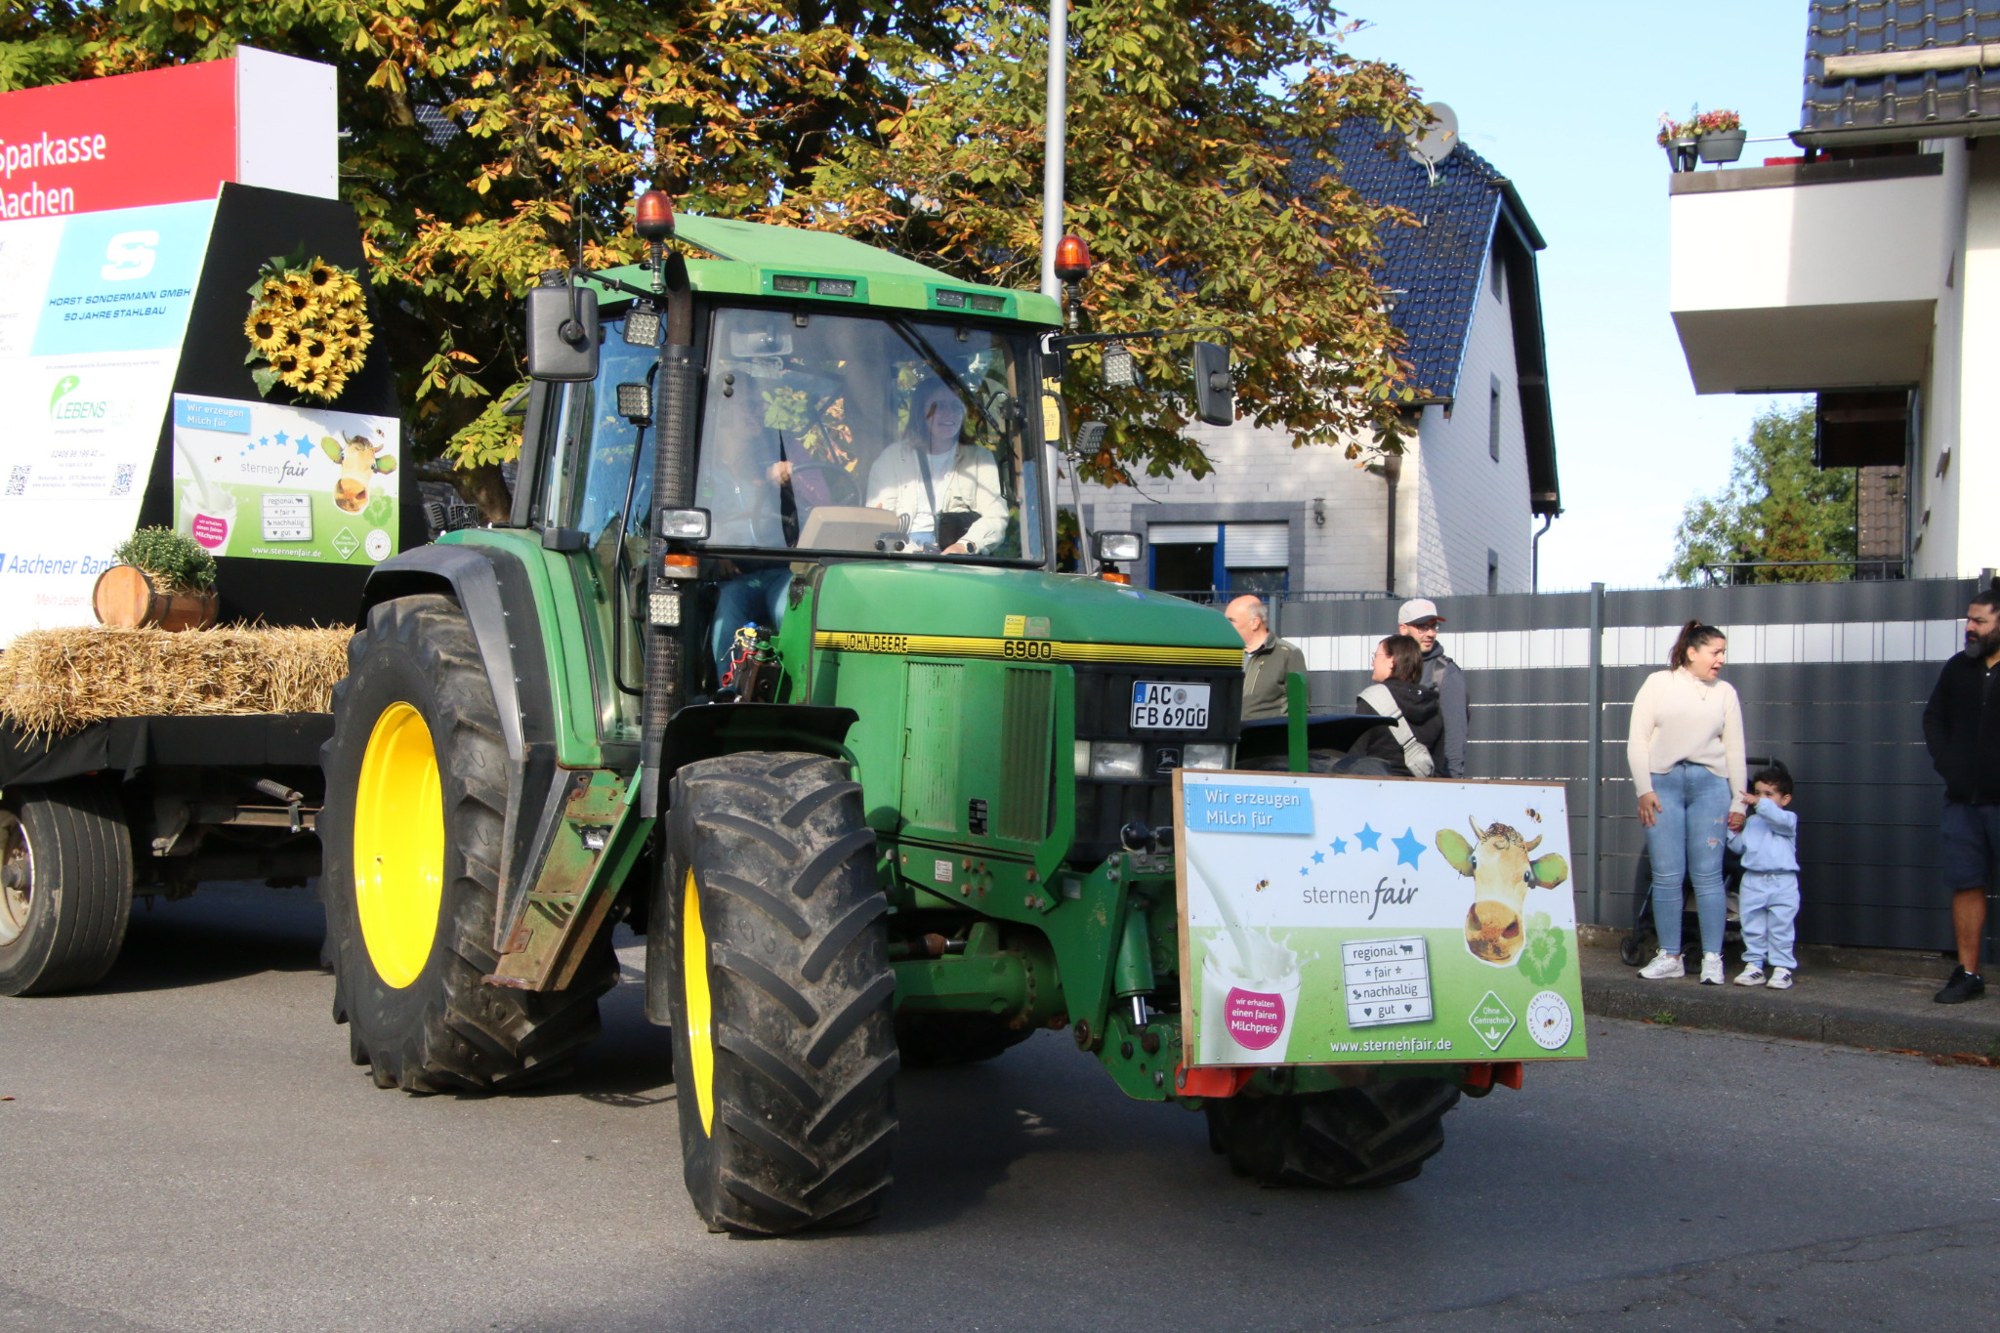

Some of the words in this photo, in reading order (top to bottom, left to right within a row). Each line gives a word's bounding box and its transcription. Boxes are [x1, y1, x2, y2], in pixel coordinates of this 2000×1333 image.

[49, 299, 84, 307] HORST
[85, 292, 157, 305] SONDERMANN
[159, 289, 193, 299] GMBH
[63, 313, 78, 322] 50
[78, 310, 113, 321] JAHRE
[112, 306, 167, 318] STAHLBAU
[186, 402, 203, 413] Wir
[204, 406, 244, 418] erzeugen
[187, 415, 211, 426] Milch
[214, 417, 227, 428] für
[268, 498, 294, 507] regional
[279, 509, 291, 517] fair
[280, 528, 292, 538] gut
[252, 546, 323, 559] www.sternenfair.de
[7, 553, 78, 575] Aachener
[843, 634, 870, 649] JOHN
[873, 635, 908, 652] DEERE
[1004, 640, 1052, 660] 6900
[1148, 685, 1172, 705] AC
[1135, 706, 1159, 726] FB
[1162, 707, 1207, 727] 6900
[1205, 789, 1230, 804] Wir
[1234, 792, 1301, 809] erzeugen
[1206, 810, 1247, 826] Milch
[1251, 811, 1273, 829] für
[1352, 945, 1398, 961] regional
[1373, 966, 1392, 981] fair
[1363, 984, 1418, 998] nachhaltig
[1235, 997, 1246, 1005] wir
[1247, 998, 1275, 1008] erhalten
[1483, 1006, 1501, 1015] Ohne
[1231, 1008, 1254, 1018] einen
[1255, 1009, 1278, 1020] fairen
[1378, 1005, 1396, 1019] gut
[1231, 1019, 1279, 1035] Milchpreis
[1330, 1037, 1452, 1054] www.sternenfair.de
